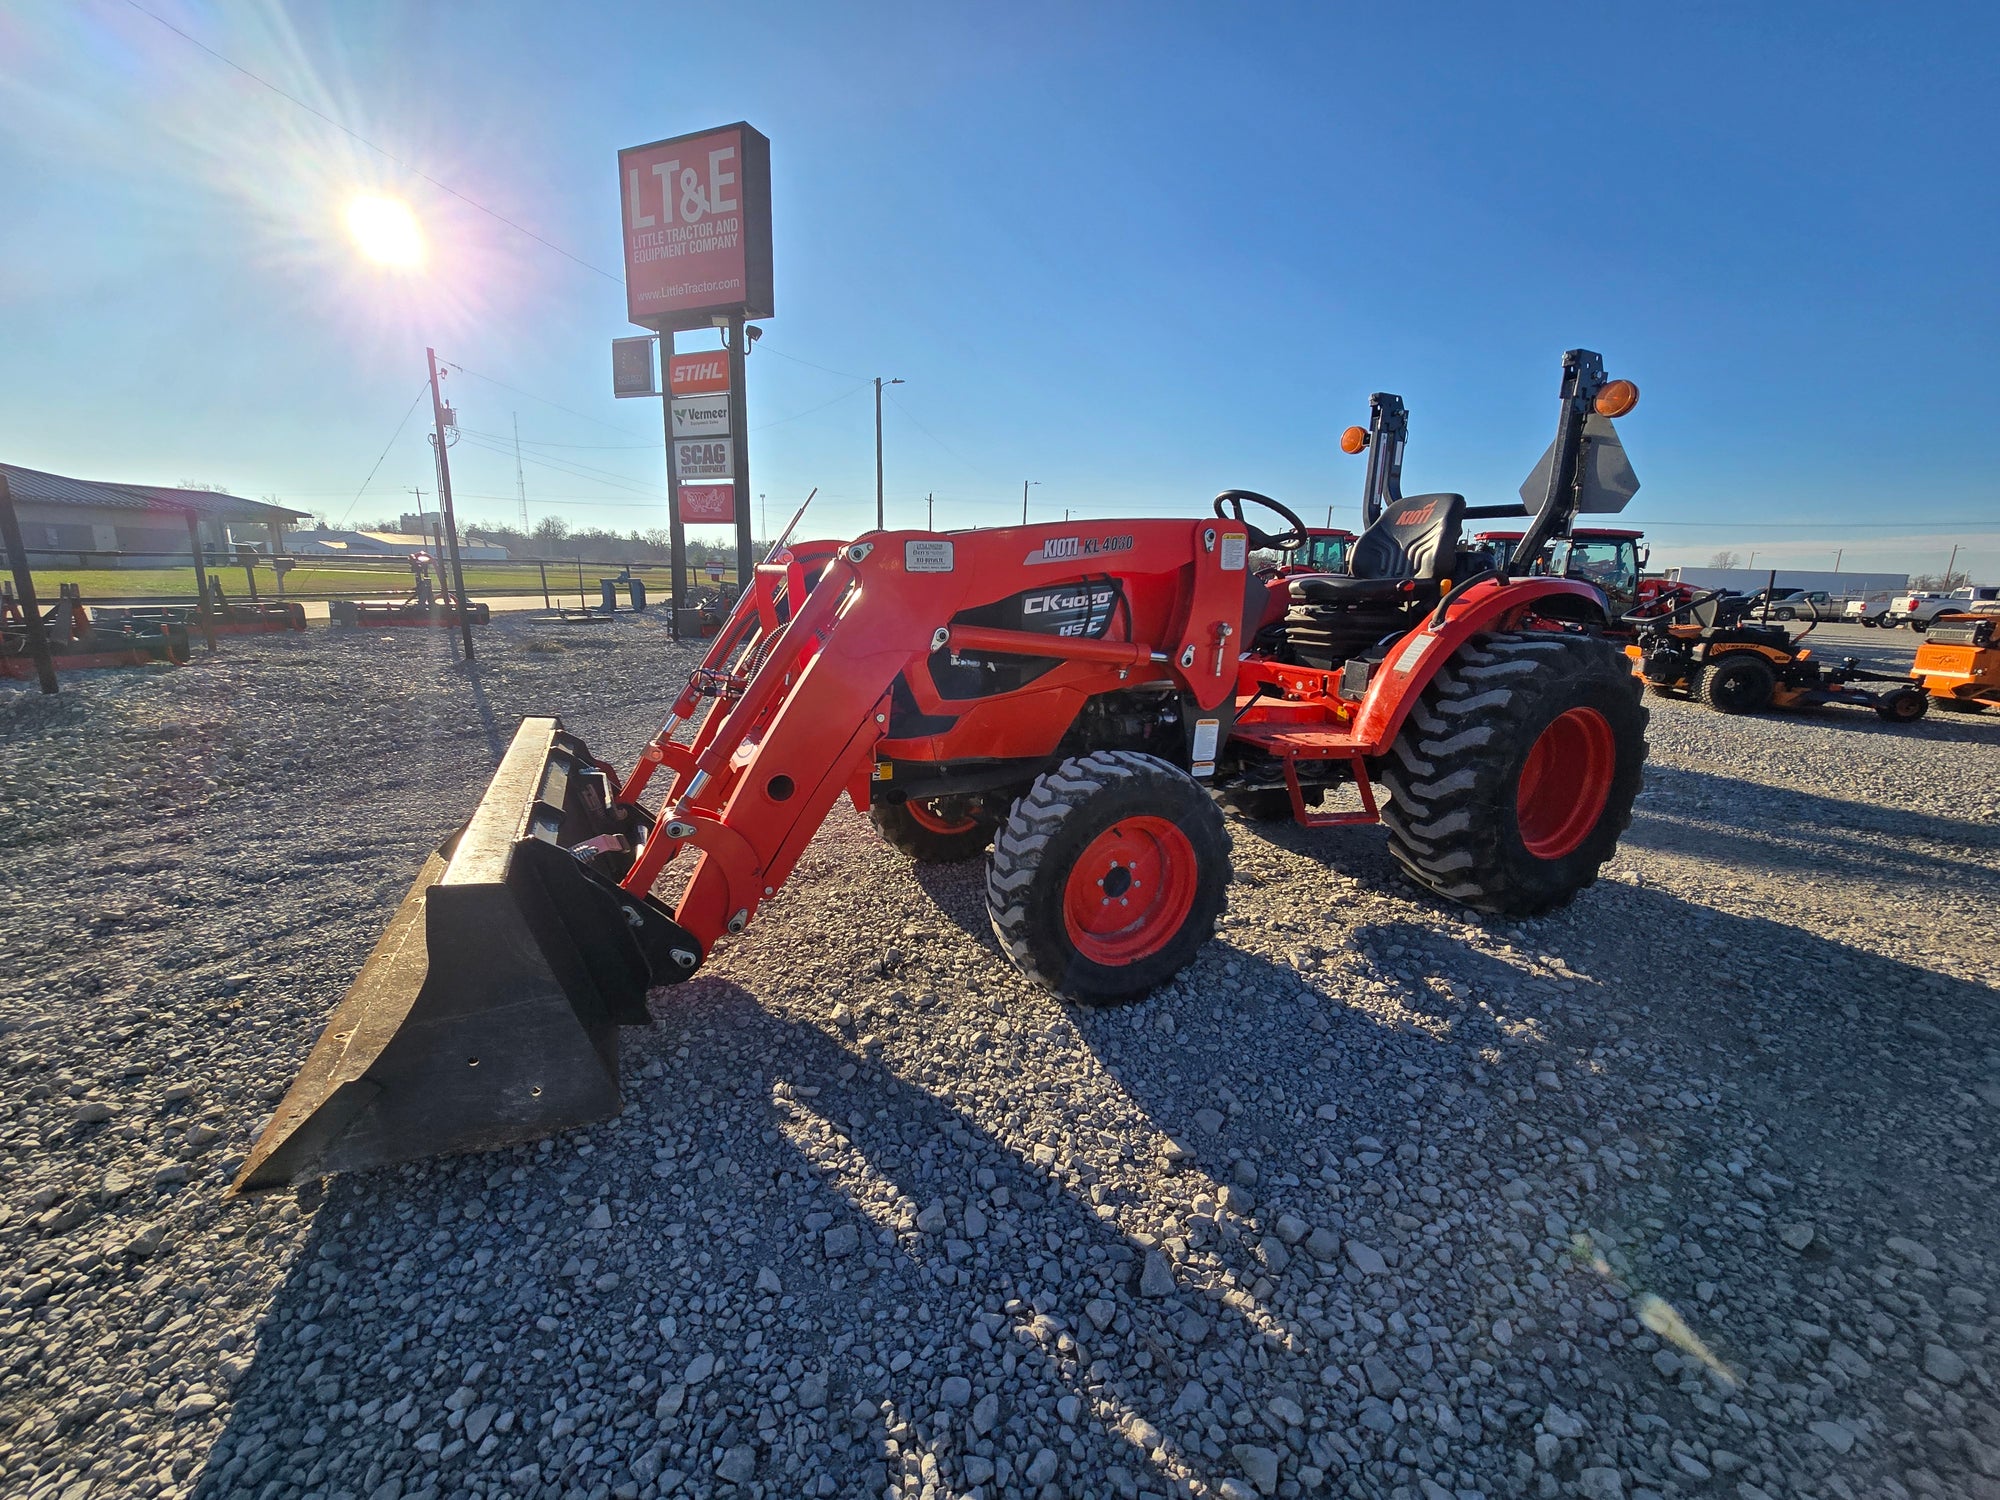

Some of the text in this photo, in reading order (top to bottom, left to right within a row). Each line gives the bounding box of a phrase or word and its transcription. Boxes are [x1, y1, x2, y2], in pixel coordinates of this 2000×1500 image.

[629, 147, 738, 230] LT&E
[633, 217, 738, 250] LITTLE TRACTOR AND
[634, 233, 738, 264] EQUIPMENT COMPANY
[637, 277, 740, 301] www.LittleTractor.com
[673, 362, 722, 382] STIHL
[688, 408, 727, 420] Vermeer
[680, 444, 726, 466] SCAG
[681, 464, 726, 474] POWER EQUIPMENT
[1042, 536, 1133, 559] KIOTI KL 4030
